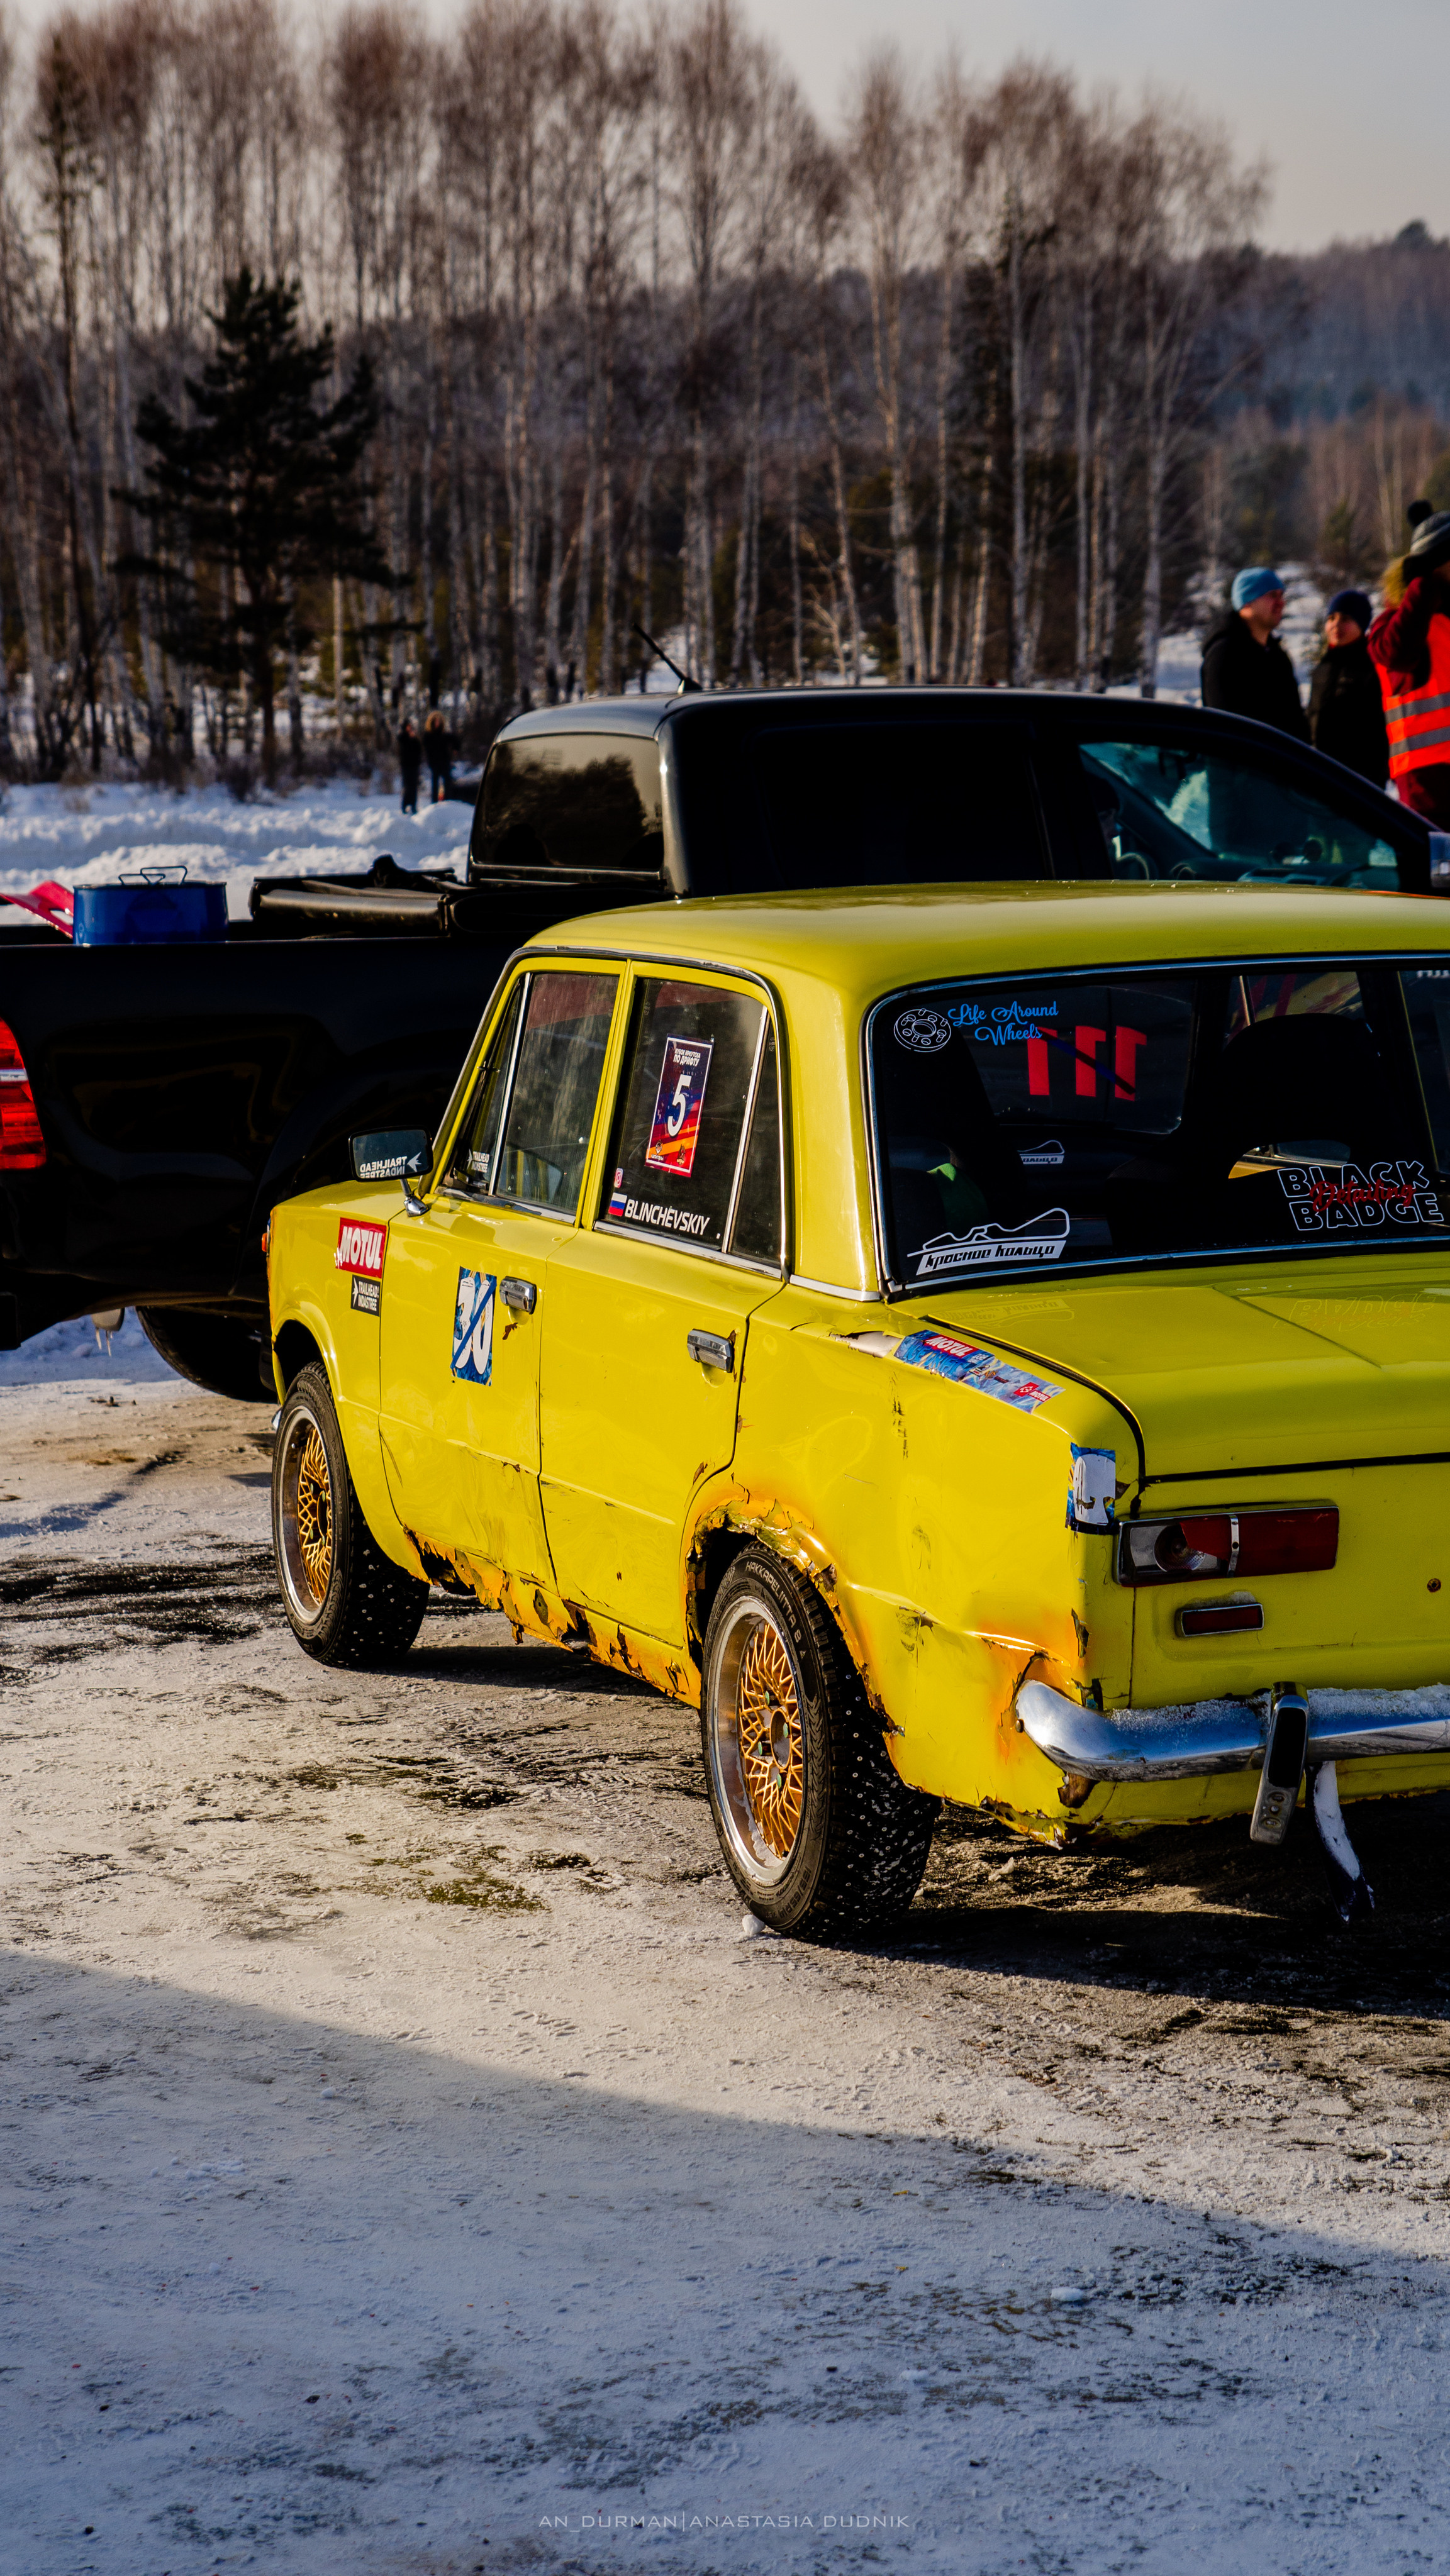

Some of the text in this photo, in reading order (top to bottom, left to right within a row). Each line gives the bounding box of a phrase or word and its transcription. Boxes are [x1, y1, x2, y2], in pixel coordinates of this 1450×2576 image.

[948, 1001, 1059, 1026] Life Around
[975, 1024, 1043, 1046] Wheels
[673, 1054, 700, 1067] ПО ДРИФТУ
[667, 1074, 692, 1138] 5
[1277, 1161, 1429, 1197] BLACK
[1309, 1179, 1416, 1213] Detailing
[625, 1199, 710, 1235] BLINCHEVSKIY
[1289, 1193, 1444, 1231] BADGE
[339, 1226, 383, 1270] MOTUL
[925, 1336, 974, 1357] MOTUL
[1029, 1391, 1049, 1401] MOTUL
[745, 1561, 802, 1643] HAKKAPELIITTA 8
